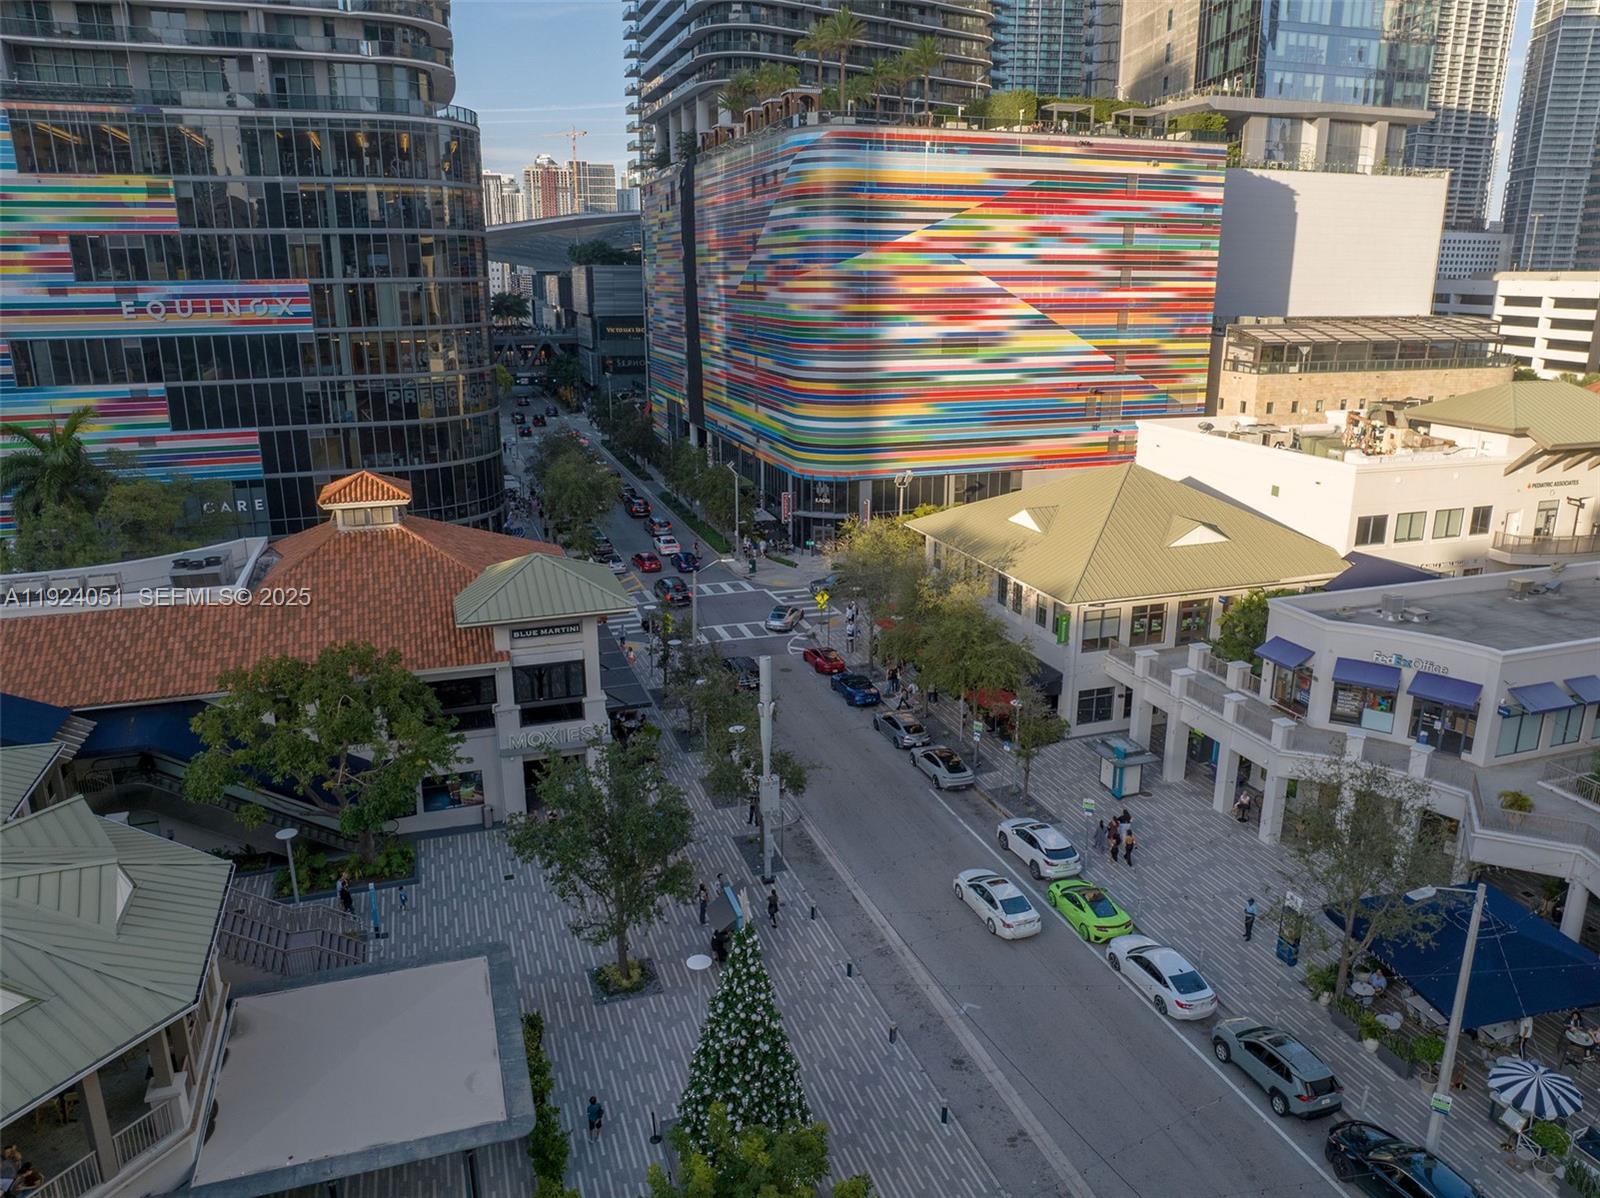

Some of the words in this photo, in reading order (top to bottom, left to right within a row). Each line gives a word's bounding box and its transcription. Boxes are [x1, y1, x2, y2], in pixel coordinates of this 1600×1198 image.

[121, 298, 294, 322] EQUINOX
[1532, 481, 1553, 489] PEDIATRIC
[1554, 479, 1579, 487] ASSOCIATES
[203, 499, 264, 513] CARE
[513, 630, 539, 638] BLUE
[540, 625, 579, 636] MARTINI
[1373, 650, 1413, 669] FedEx
[1413, 657, 1449, 675] Office
[508, 724, 594, 749] MOXIES
